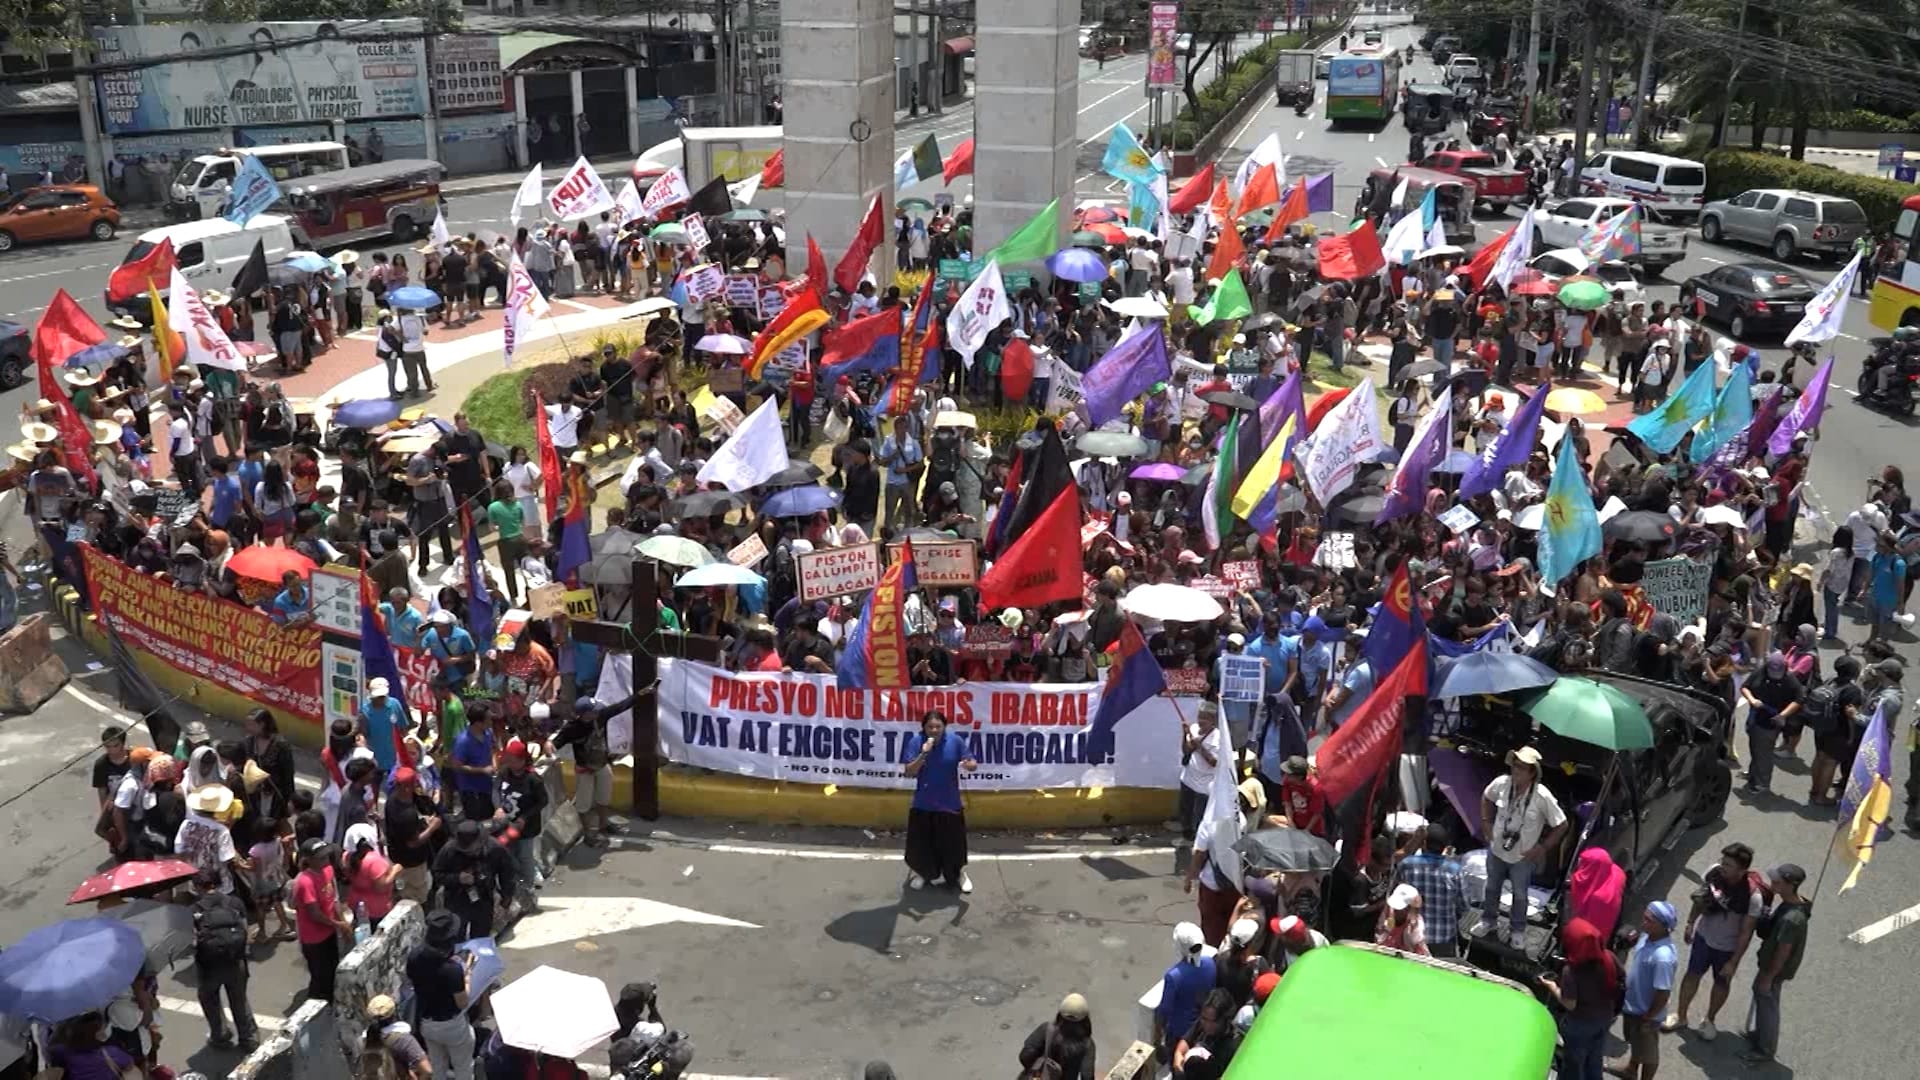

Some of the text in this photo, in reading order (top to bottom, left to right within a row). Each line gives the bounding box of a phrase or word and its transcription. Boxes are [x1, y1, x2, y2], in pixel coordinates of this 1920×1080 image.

[105, 81, 143, 94] SECTOR
[235, 87, 293, 104] RADIOLOGIC
[308, 85, 359, 102] PHYSICAL
[106, 96, 140, 109] NEEDS
[309, 101, 362, 118] THERAPIST
[184, 105, 228, 125] NURSE
[815, 551, 867, 568] PISTON
[805, 561, 875, 581] CALUMPIT
[807, 576, 875, 599] BULACAN
[566, 599, 593, 615] VAT
[872, 584, 901, 687] PISTON
[213, 637, 281, 680] KULTURA!
[710, 674, 818, 718] PRESYO
[825, 685, 865, 720] NG
[990, 691, 1089, 726] IBABA!
[681, 711, 731, 749] VAT
[738, 719, 771, 754] AT
[779, 723, 876, 764] EXCISE
[791, 764, 810, 772] NO
[813, 765, 830, 774] TO
[832, 767, 853, 776] OIL
[856, 769, 896, 778] PRICE
